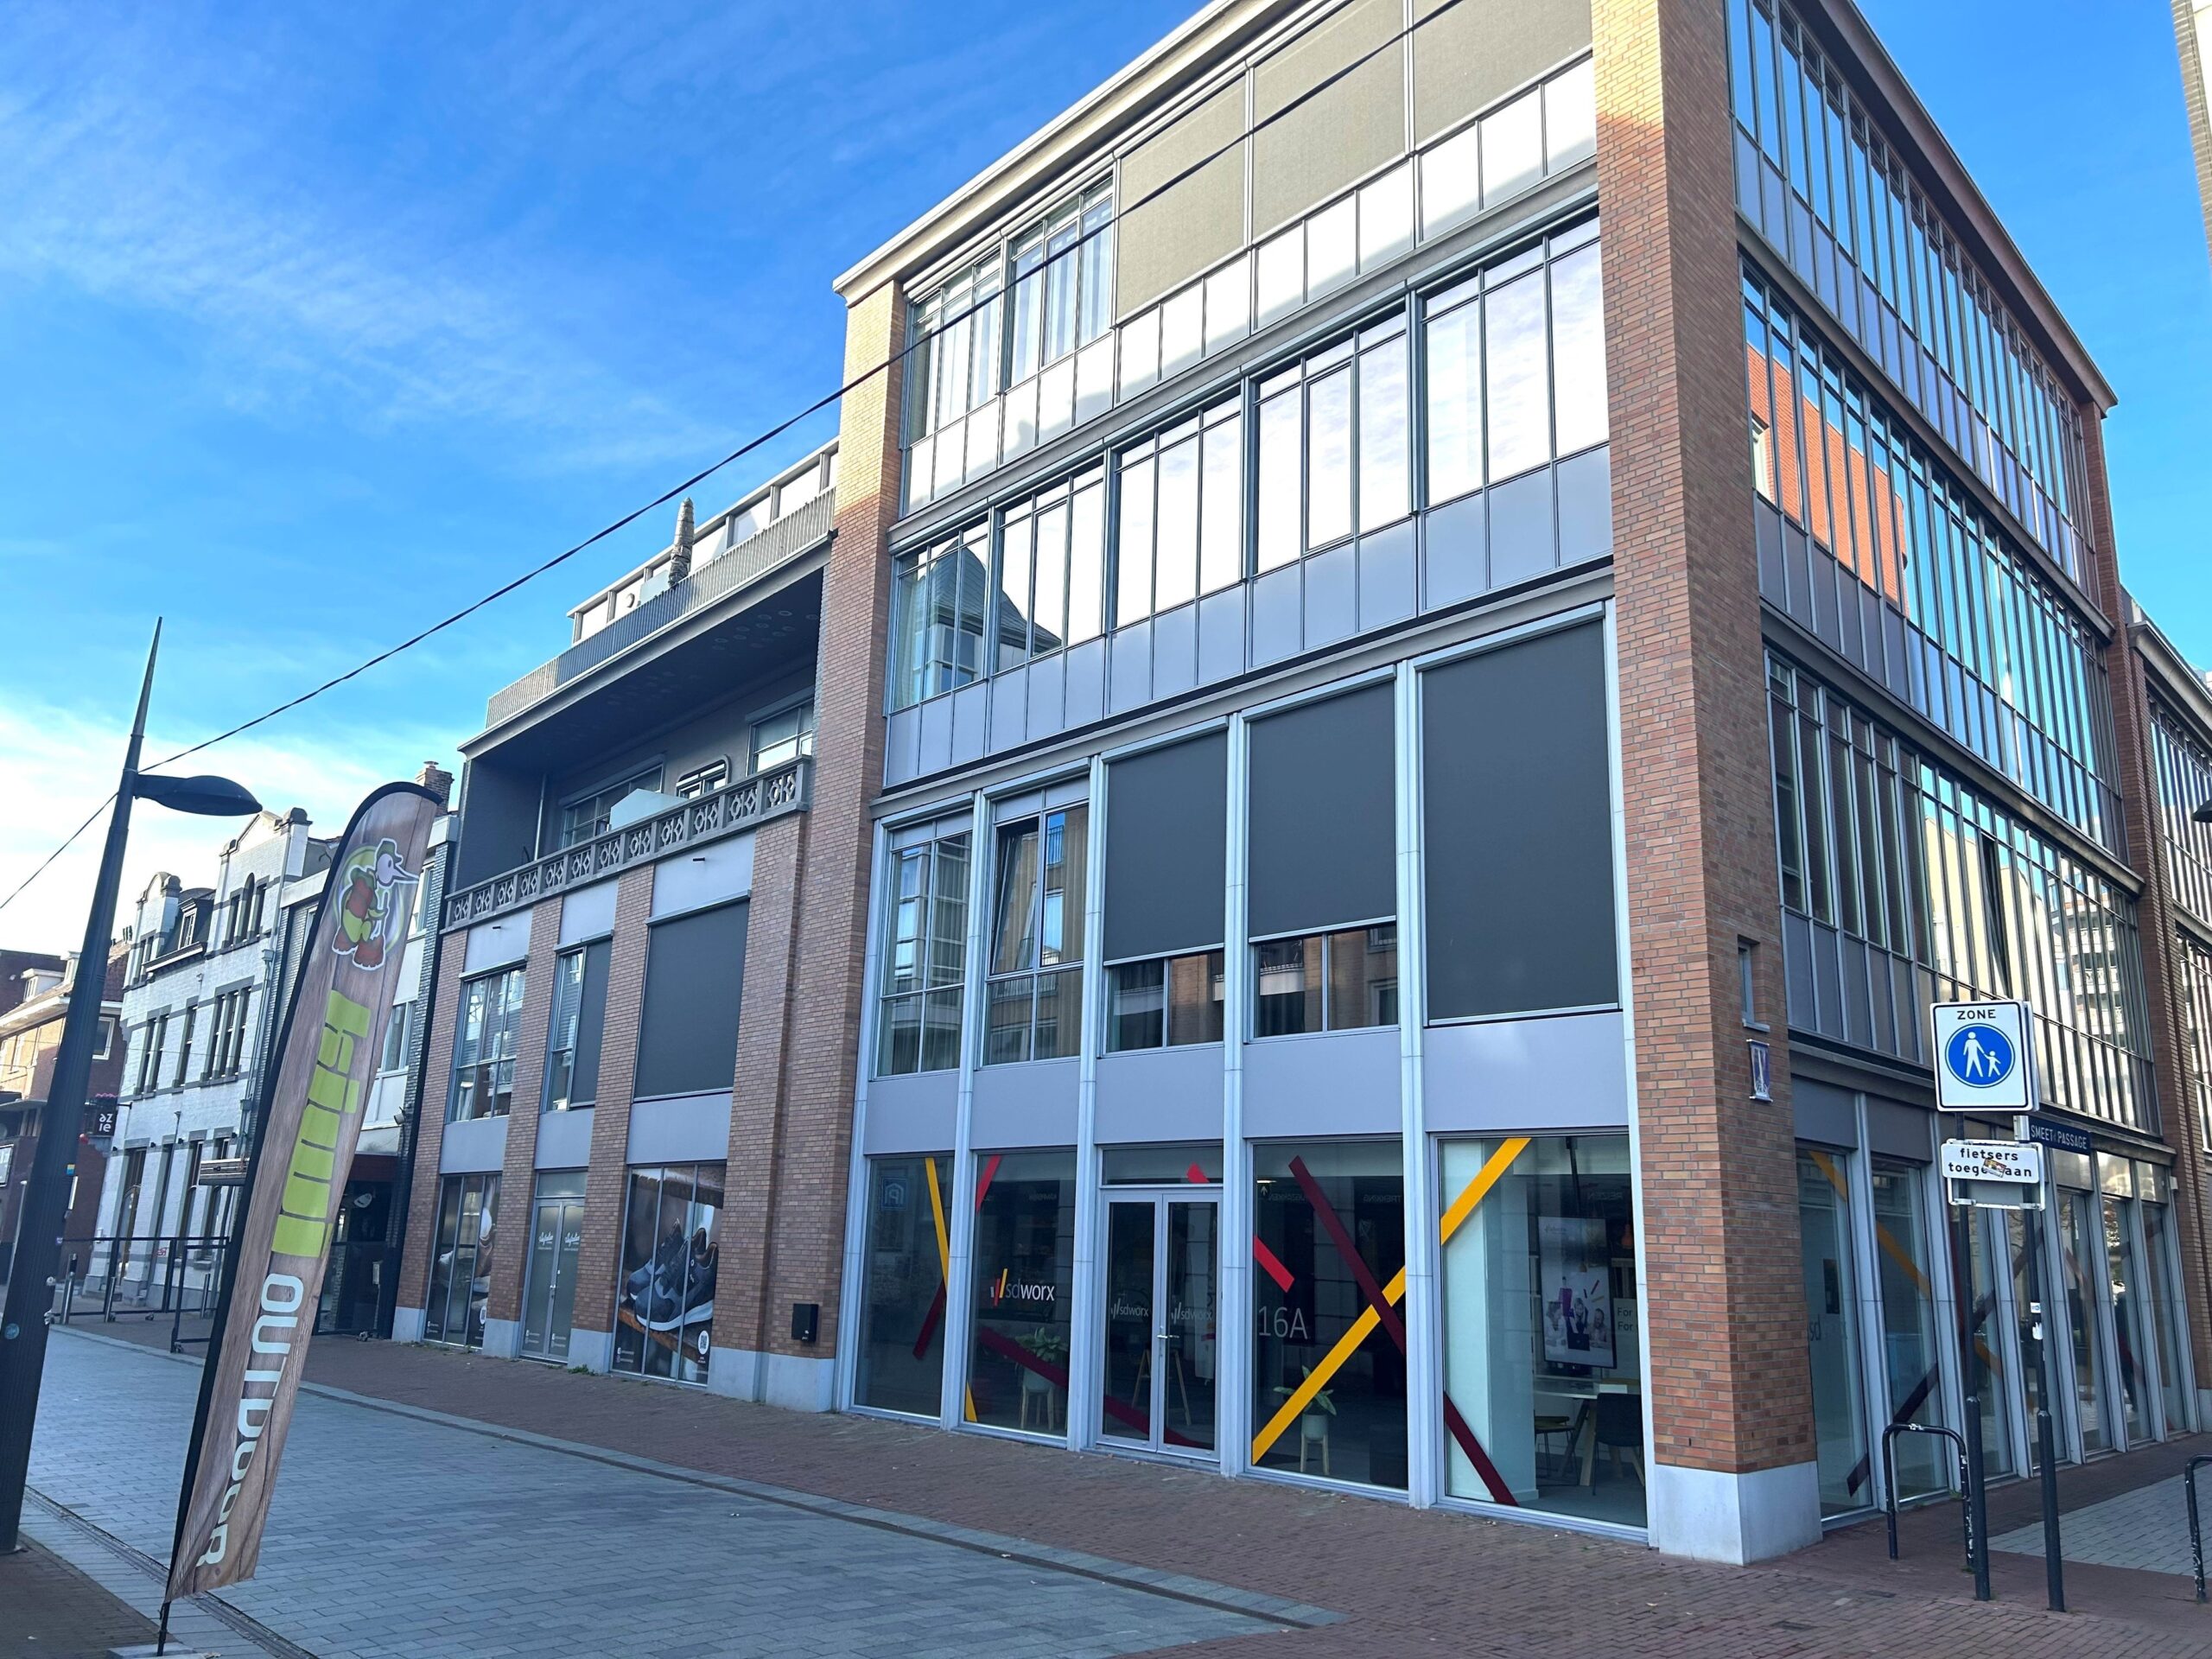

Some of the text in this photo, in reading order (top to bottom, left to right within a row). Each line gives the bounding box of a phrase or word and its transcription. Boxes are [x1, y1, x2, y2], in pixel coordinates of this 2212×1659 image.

[1956, 1008, 1997, 1020] ZONE
[1960, 1147, 2019, 1162] fietsers
[1617, 1306, 1633, 1317] For
[1259, 1306, 1308, 1340] 16A
[1618, 1321, 1633, 1332] For
